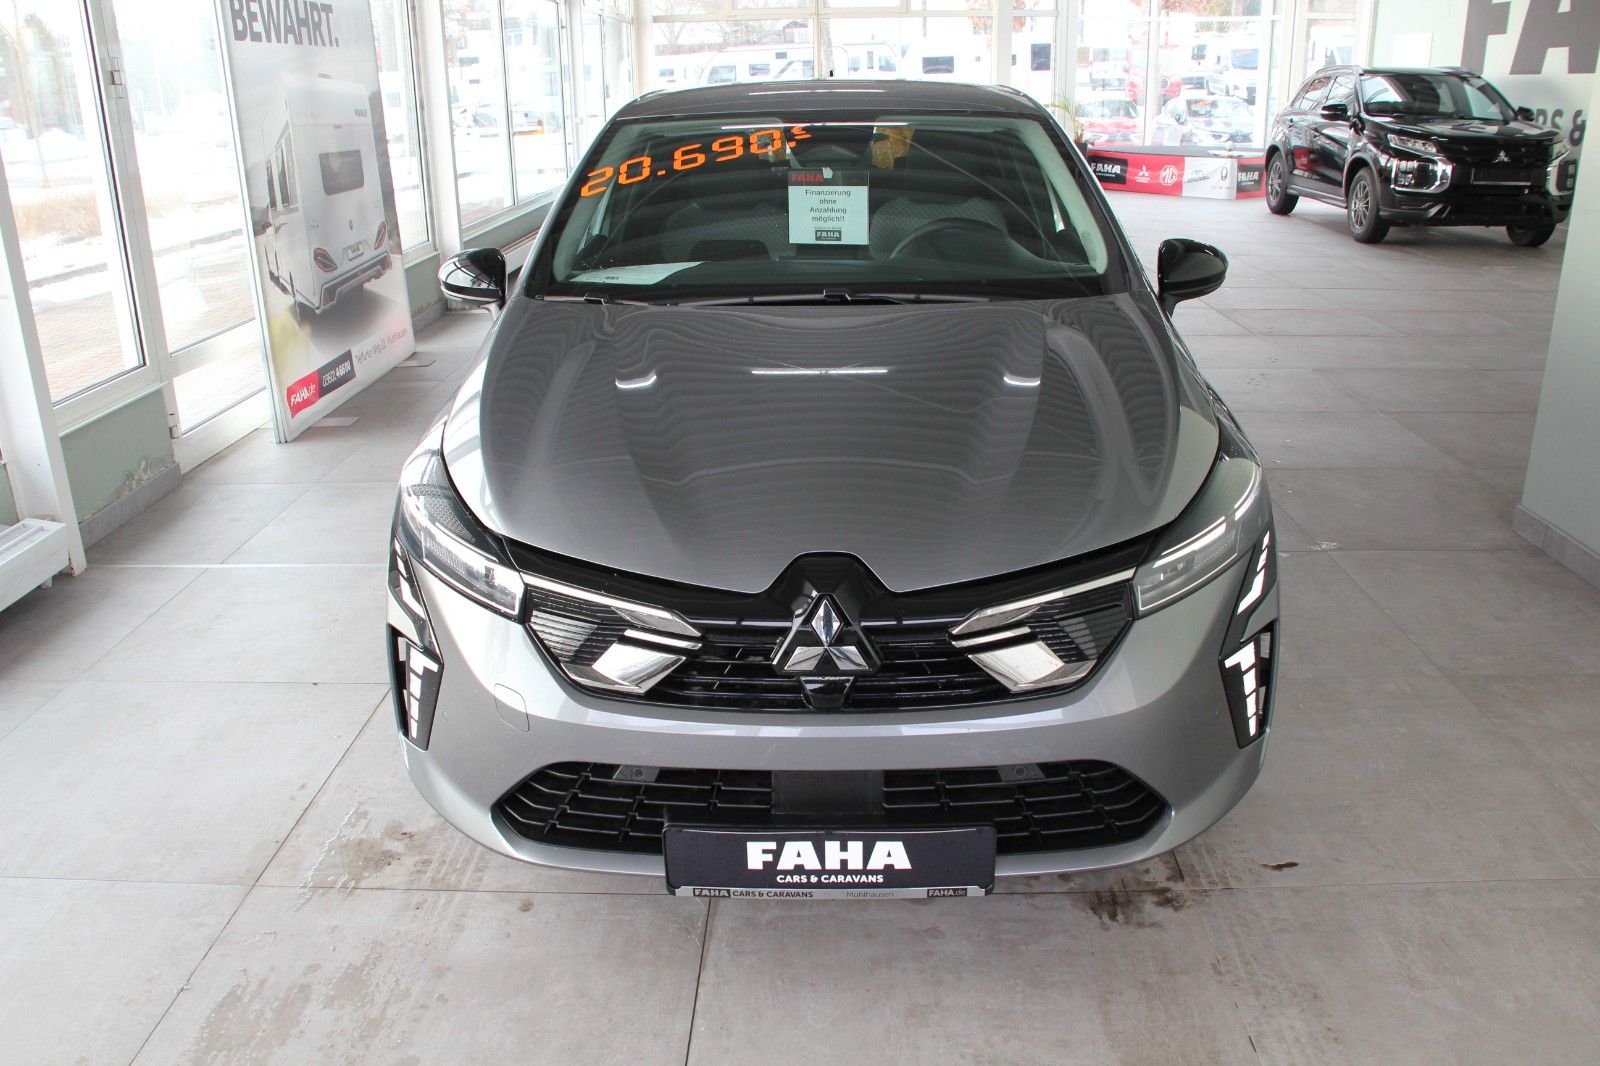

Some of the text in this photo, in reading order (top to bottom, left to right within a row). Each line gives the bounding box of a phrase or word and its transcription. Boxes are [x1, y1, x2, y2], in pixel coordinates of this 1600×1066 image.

[229, 0, 340, 47] BEWAHRT.
[1090, 162, 1121, 174] FAHA
[1237, 171, 1260, 182] FAHA
[805, 189, 851, 197] Finanzierung
[809, 206, 847, 214] Anzahlung
[746, 840, 912, 870] FAHA
[776, 874, 884, 883] CARS & CARAVANS
[693, 888, 730, 897] FAHA
